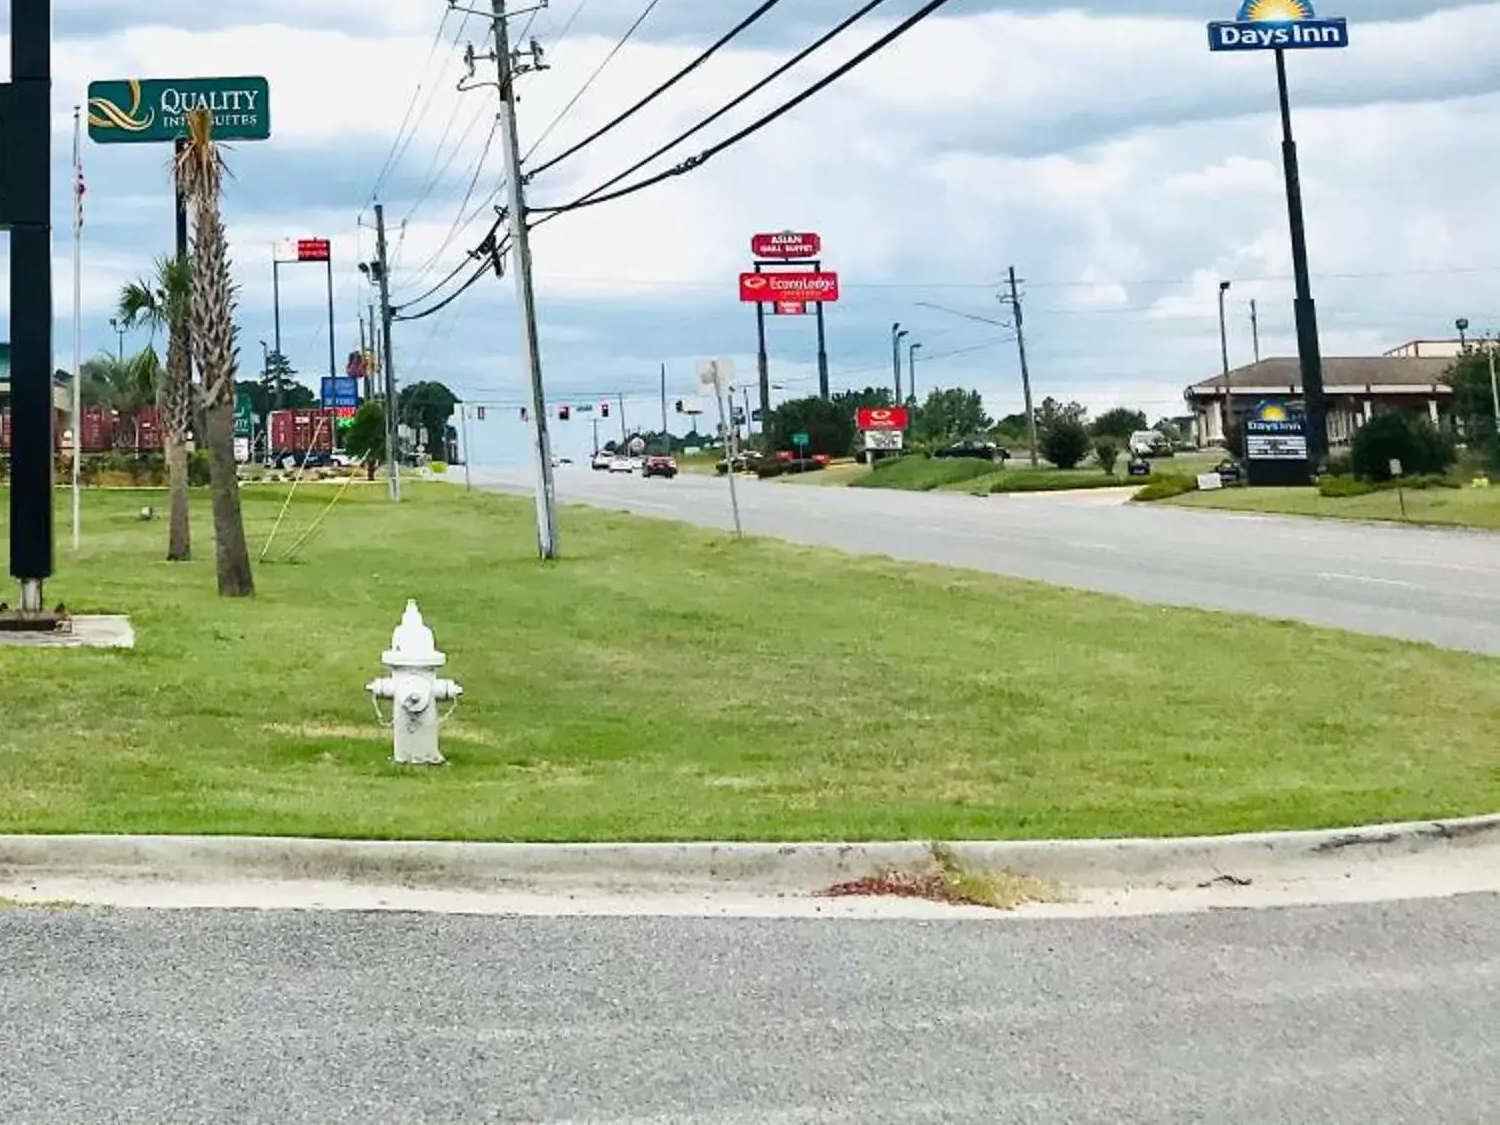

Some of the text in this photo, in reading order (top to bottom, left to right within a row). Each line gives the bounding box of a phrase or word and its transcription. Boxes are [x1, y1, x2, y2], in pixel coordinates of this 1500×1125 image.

[1220, 24, 1340, 46] Days Inn
[160, 88, 259, 114] QUALITY
